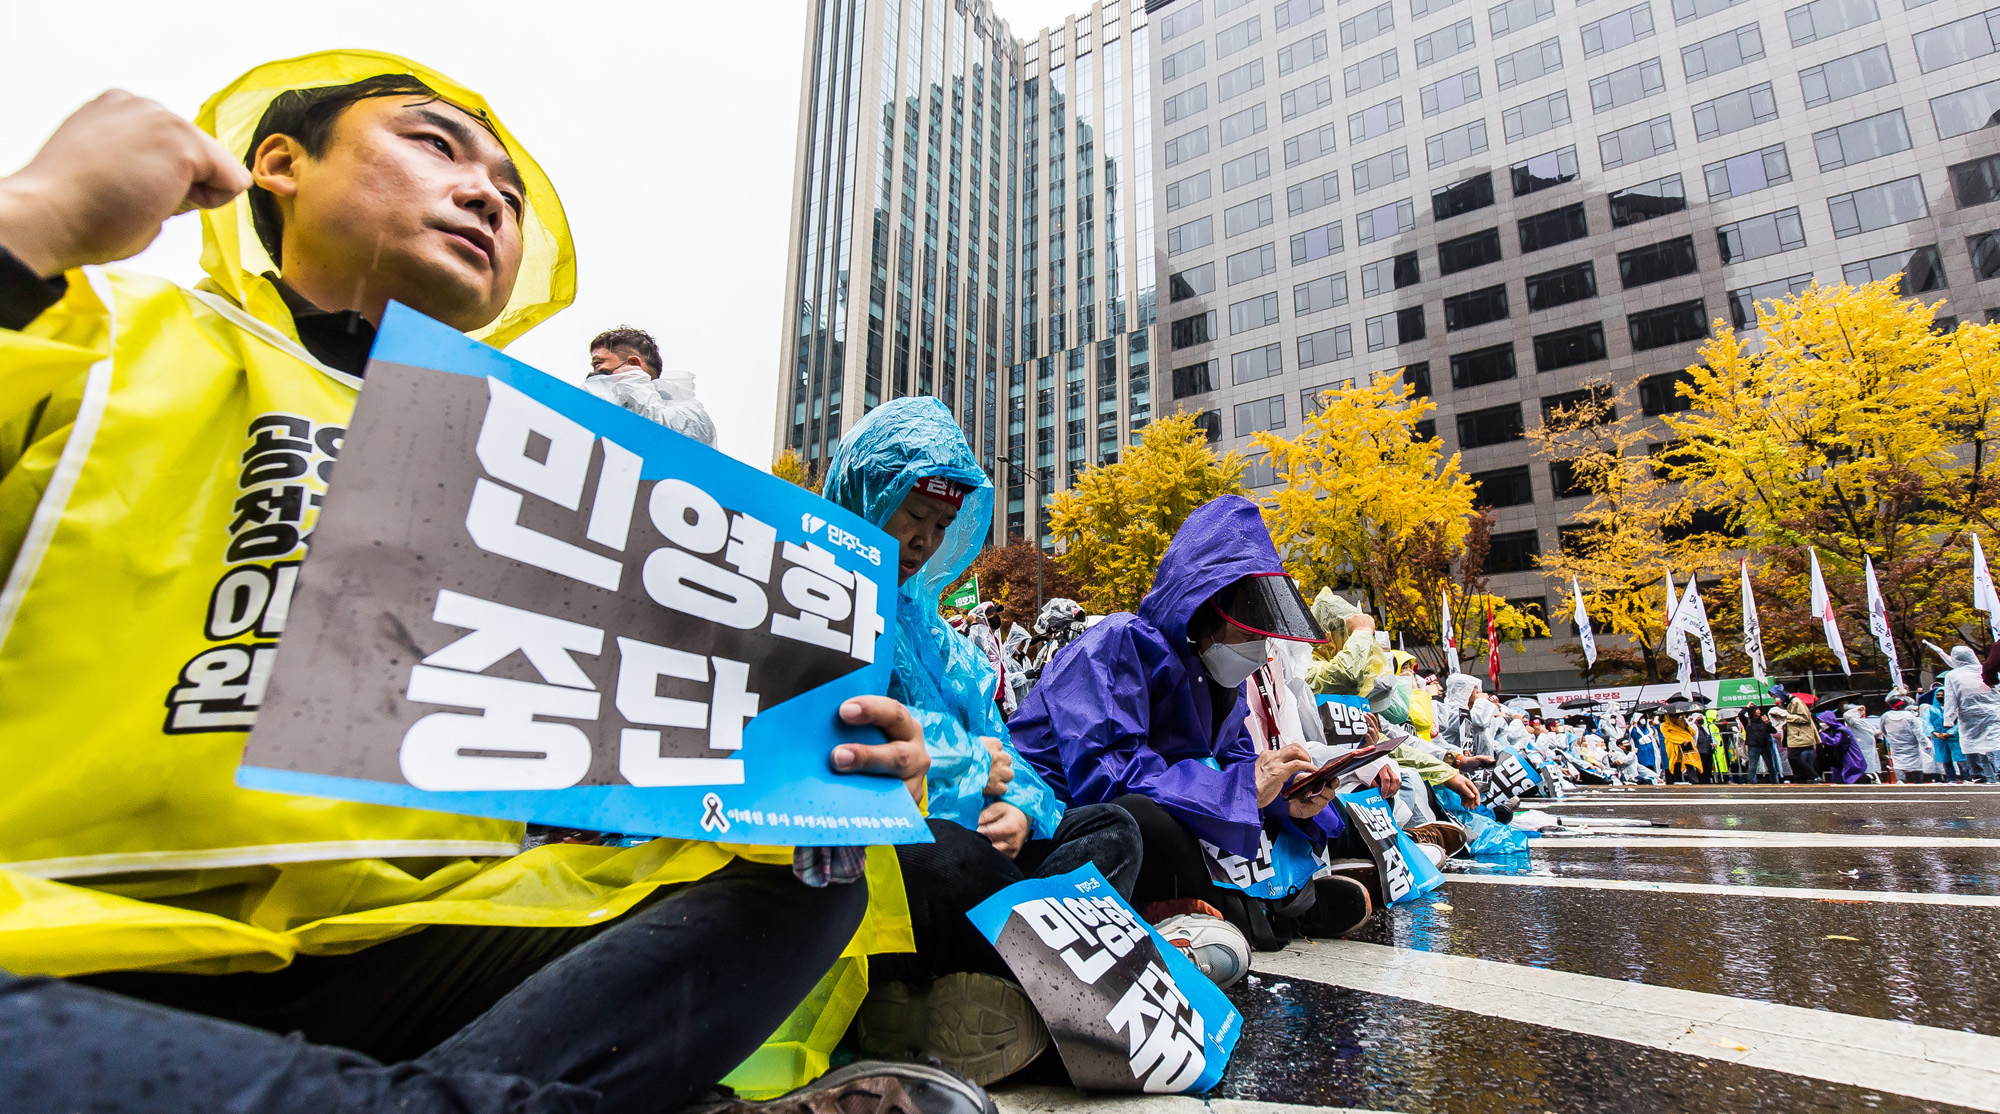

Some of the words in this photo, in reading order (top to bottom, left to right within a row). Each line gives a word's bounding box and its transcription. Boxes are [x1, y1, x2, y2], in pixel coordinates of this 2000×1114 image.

[466, 375, 884, 663] 민영화
[827, 523, 881, 567] 민주노총
[400, 589, 760, 791] 중단
[1327, 701, 1369, 736] 민영
[1011, 895, 1149, 985] 민영화
[1105, 960, 1206, 1093] 중단
